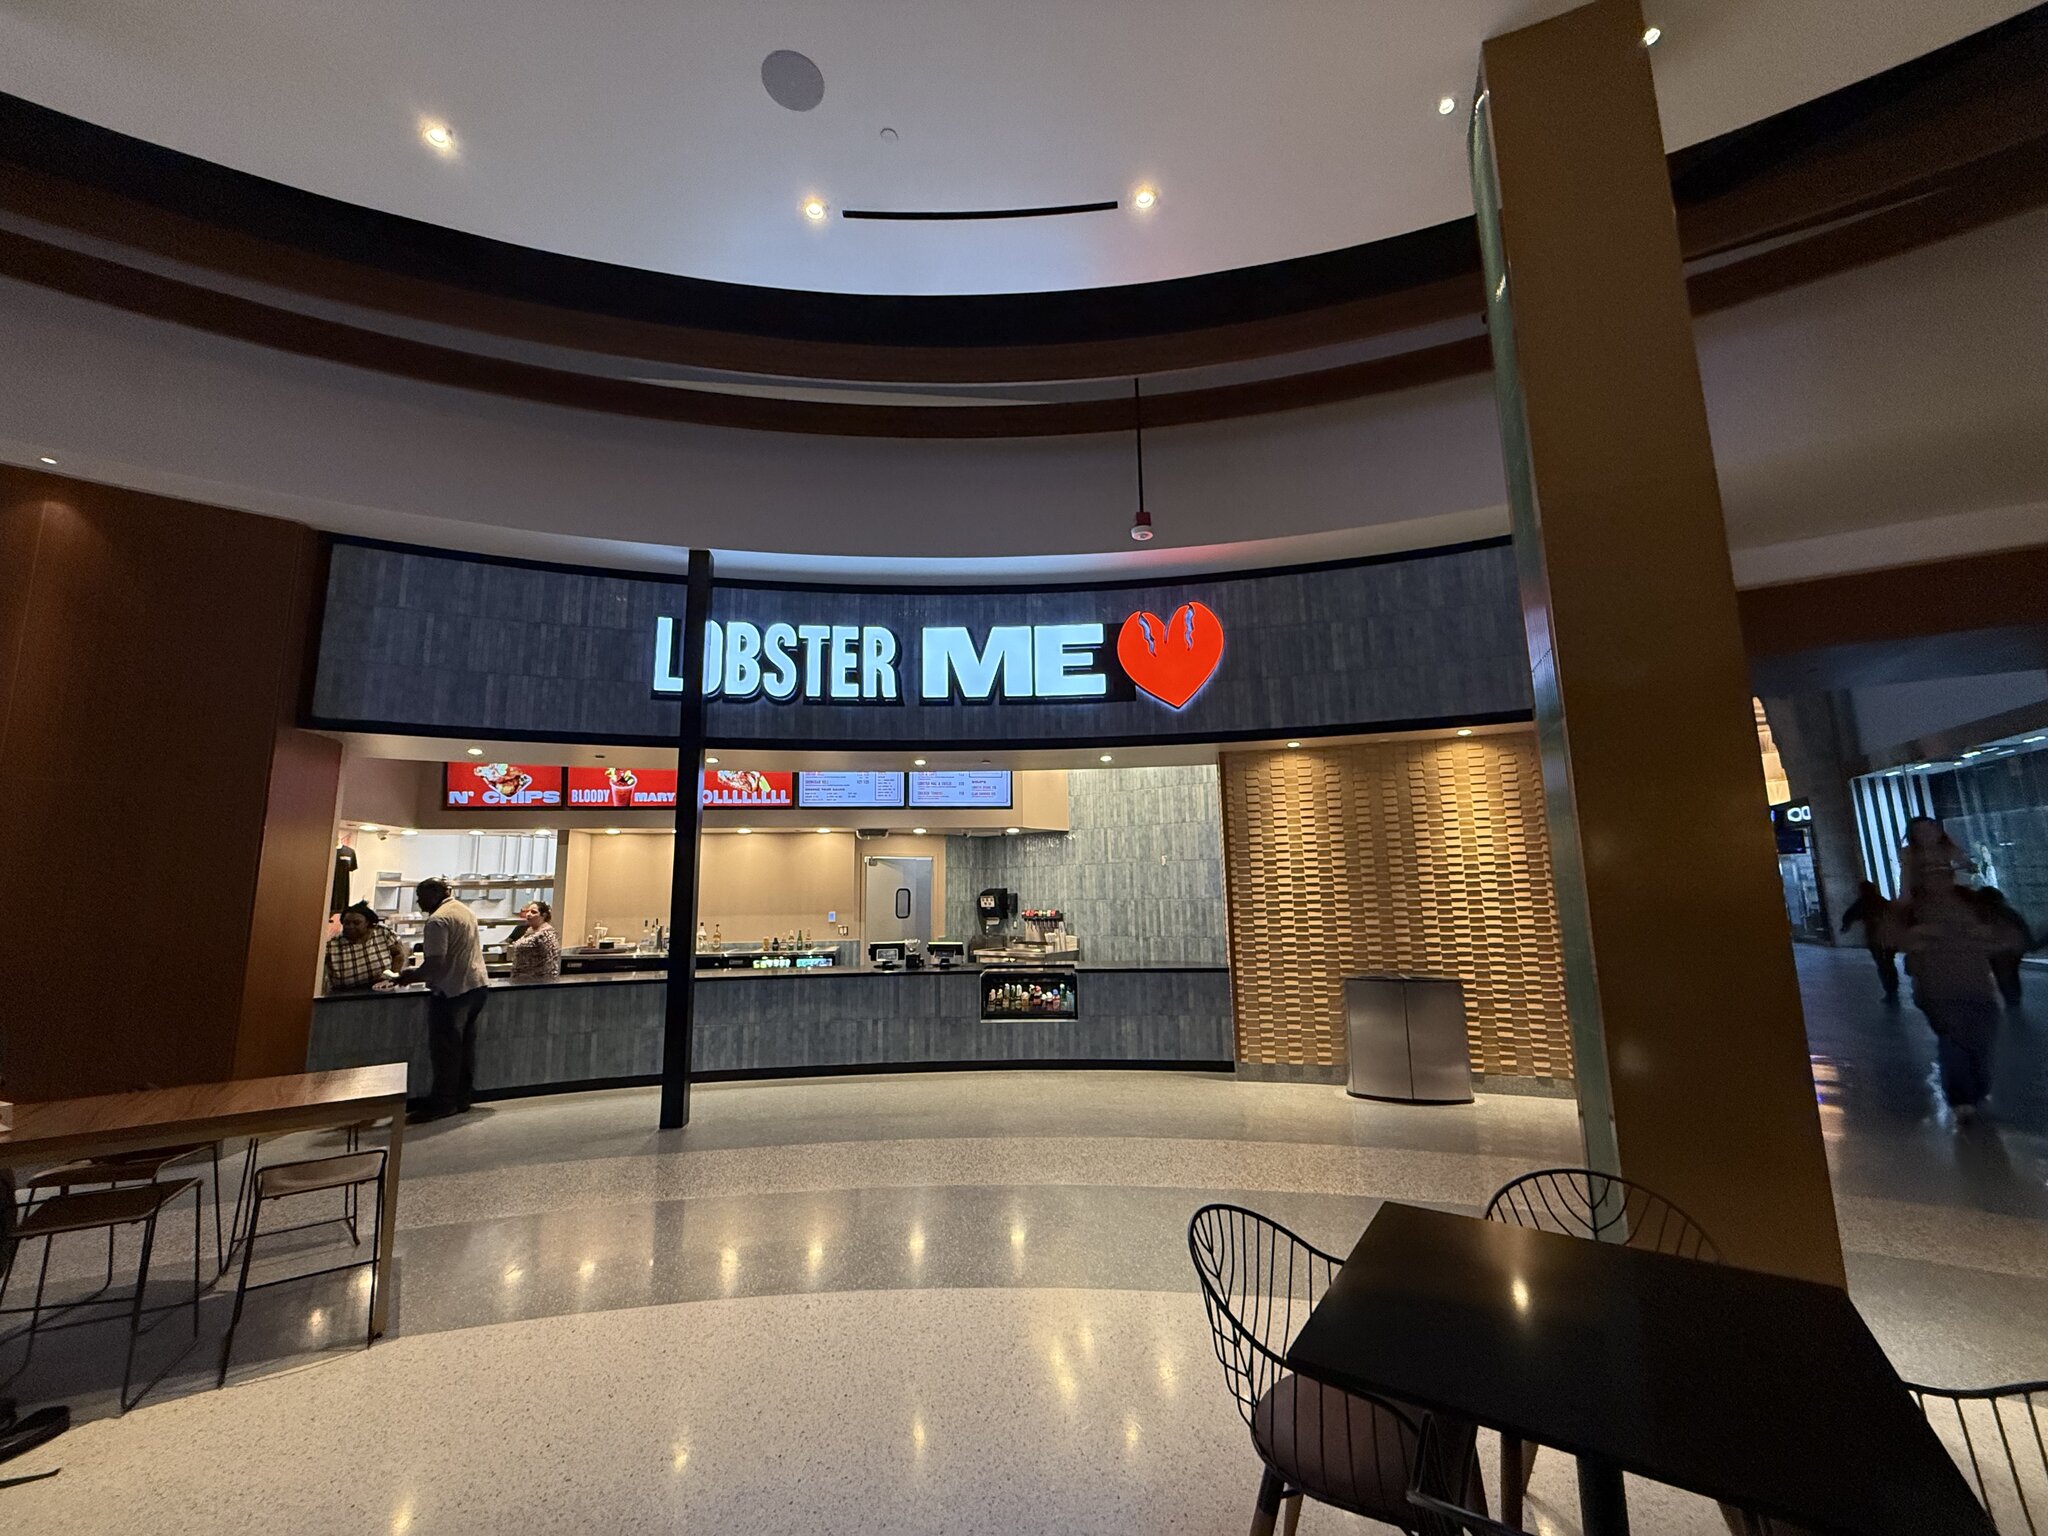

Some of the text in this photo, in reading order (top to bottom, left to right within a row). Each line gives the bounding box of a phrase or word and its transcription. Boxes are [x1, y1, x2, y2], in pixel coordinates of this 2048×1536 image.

[921, 623, 1108, 700] ME
[571, 789, 674, 803] BLOODY MARY
